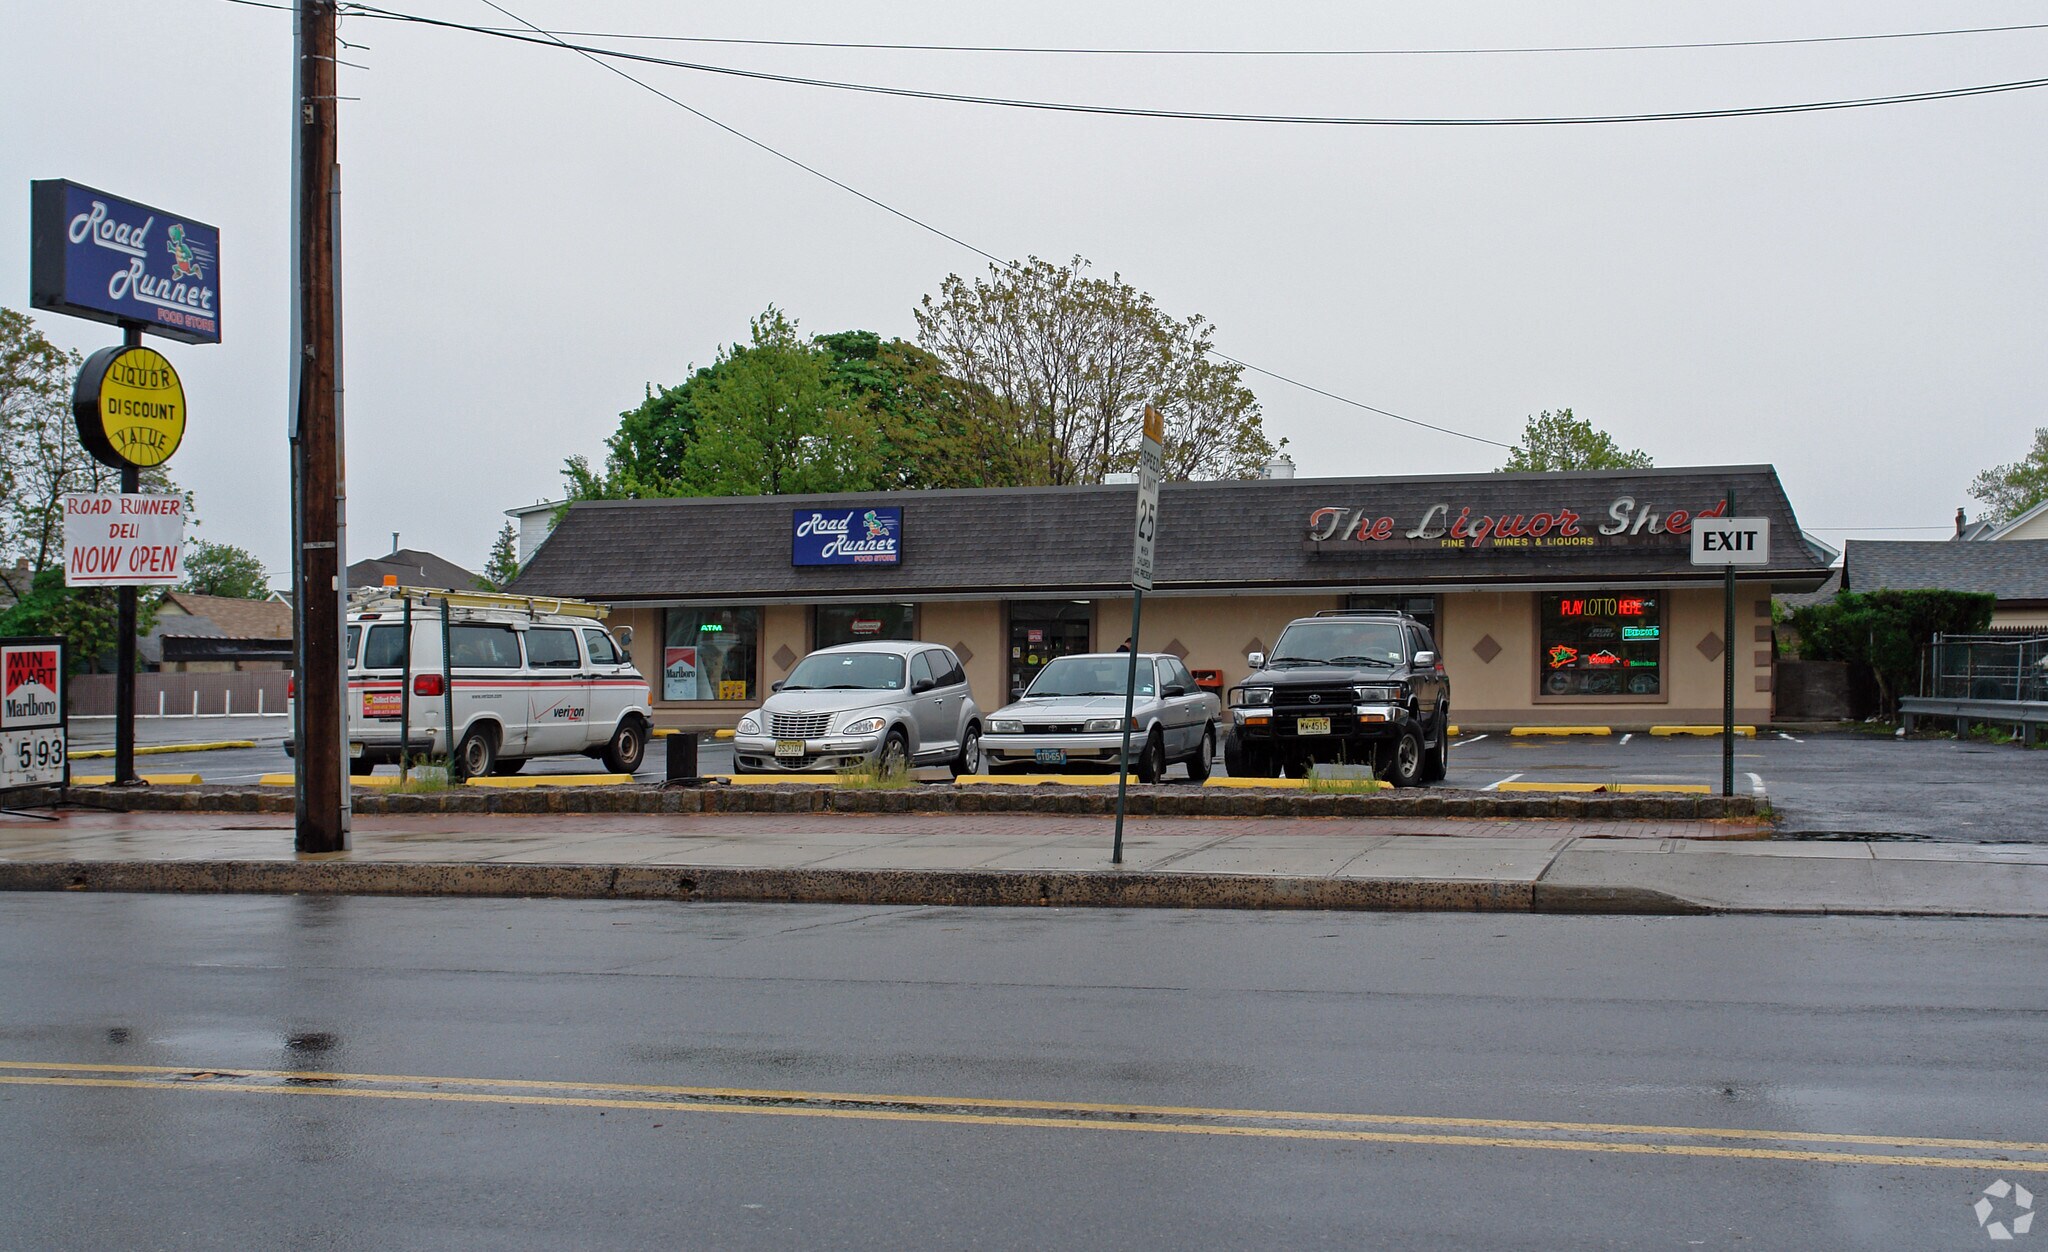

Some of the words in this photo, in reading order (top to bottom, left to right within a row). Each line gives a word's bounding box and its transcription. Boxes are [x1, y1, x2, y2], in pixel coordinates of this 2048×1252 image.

[69, 201, 154, 257] Road
[108, 257, 215, 318] Runner
[157, 307, 184, 325] FOOD
[184, 314, 216, 332] STORE
[112, 364, 170, 388] LIQUOR
[108, 398, 176, 421] DISCOUNT
[1143, 450, 1159, 474] SPEED
[1142, 473, 1157, 495] LIMIT
[67, 498, 112, 515] ROAD
[119, 498, 180, 515] RUNNER
[109, 523, 140, 539] DELI
[796, 511, 855, 537] Road
[1138, 498, 1155, 542] 25
[1309, 506, 1395, 542] The
[1405, 502, 1580, 548] Liquor
[821, 533, 897, 558] Runner
[1441, 539, 1465, 548] FINE
[1494, 538, 1528, 547] WINES
[1535, 537, 1541, 546] &
[1547, 537, 1594, 546] LIQUORS
[1703, 531, 1758, 551] EXIT
[71, 545, 122, 574] NOW
[129, 545, 178, 573] OPEN
[1561, 600, 1584, 615] PLAY
[1584, 598, 1617, 616] LOTTO
[1618, 599, 1643, 615] HERE
[700, 624, 722, 632] ATM
[8, 668, 56, 686] MART
[666, 666, 695, 678] Marlboro
[6, 693, 56, 718] Marlboro
[553, 705, 584, 720] verizon
